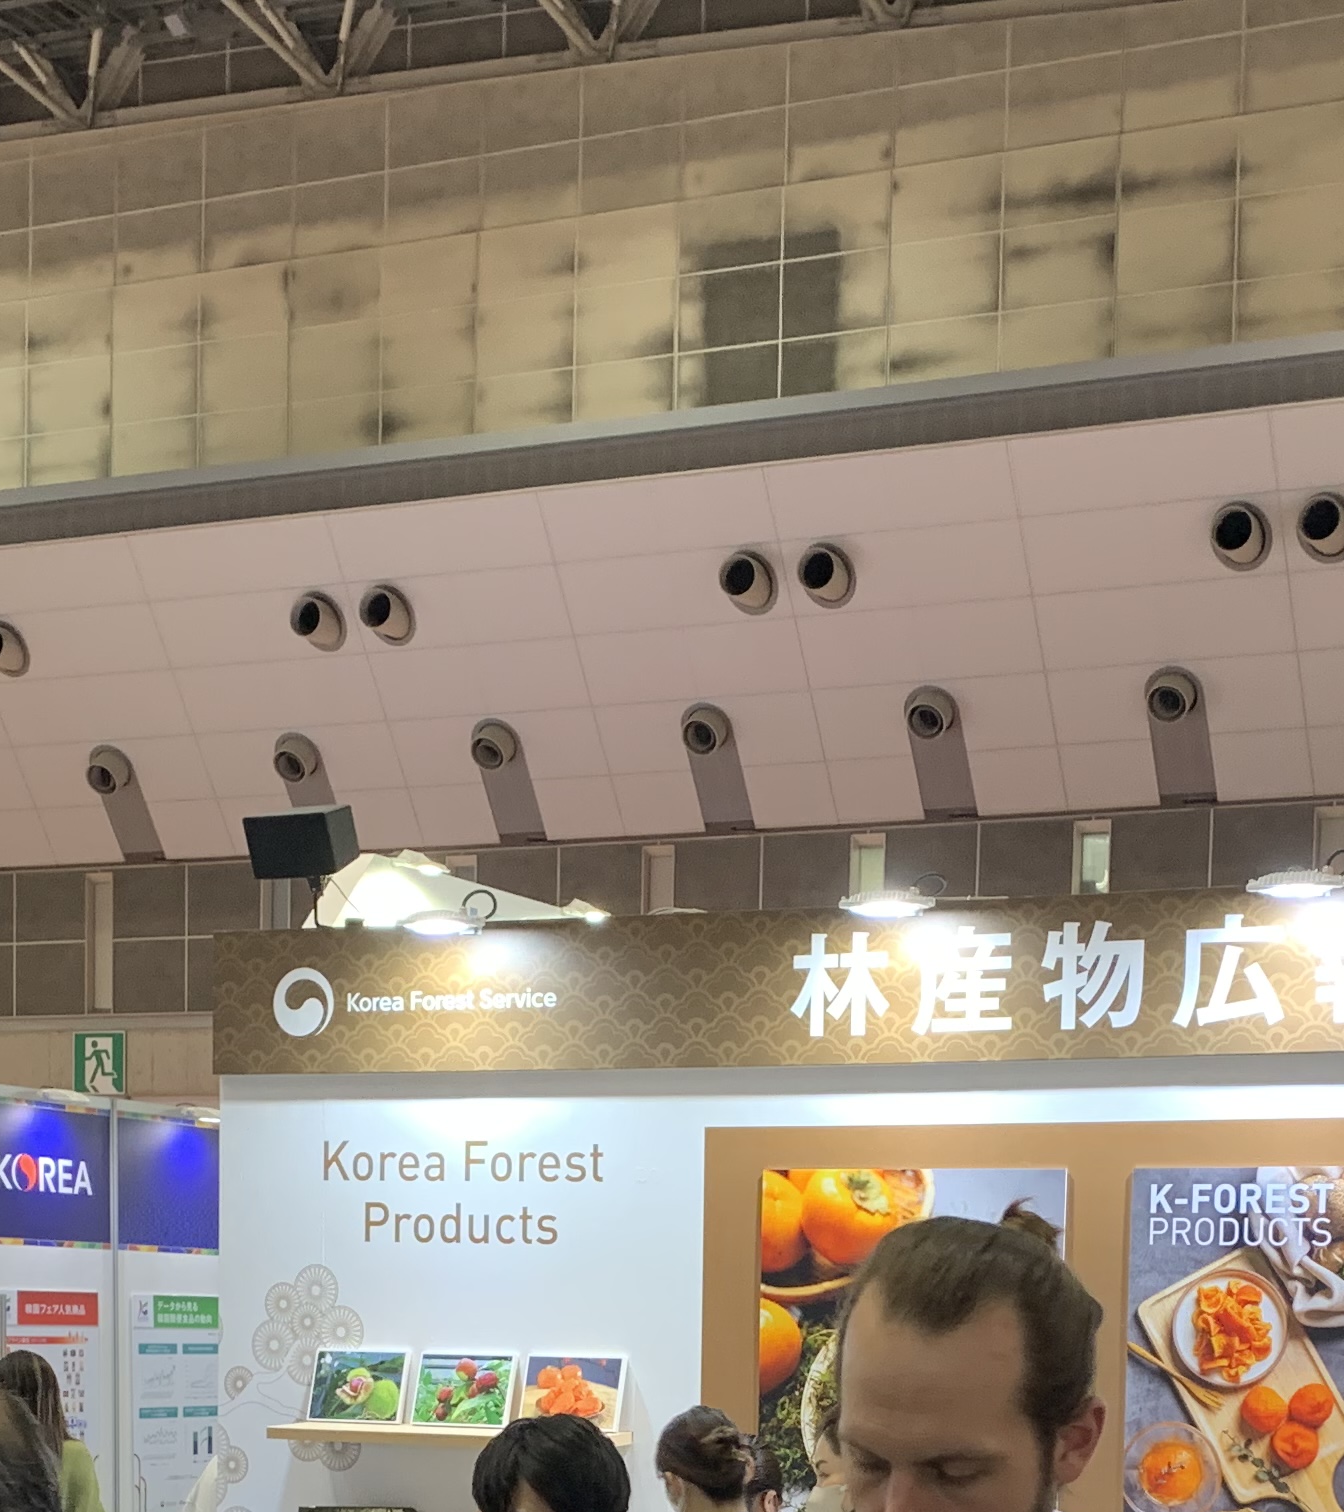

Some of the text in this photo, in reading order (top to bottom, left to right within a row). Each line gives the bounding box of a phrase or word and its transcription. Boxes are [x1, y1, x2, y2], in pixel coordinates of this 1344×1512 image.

[347, 987, 557, 1012] Korea Forest Service
[323, 1140, 604, 1183] Korea Forest
[1149, 1183, 1335, 1214] K-FOREST
[363, 1201, 558, 1245] Products
[1149, 1217, 1333, 1247] PRODUCTS
